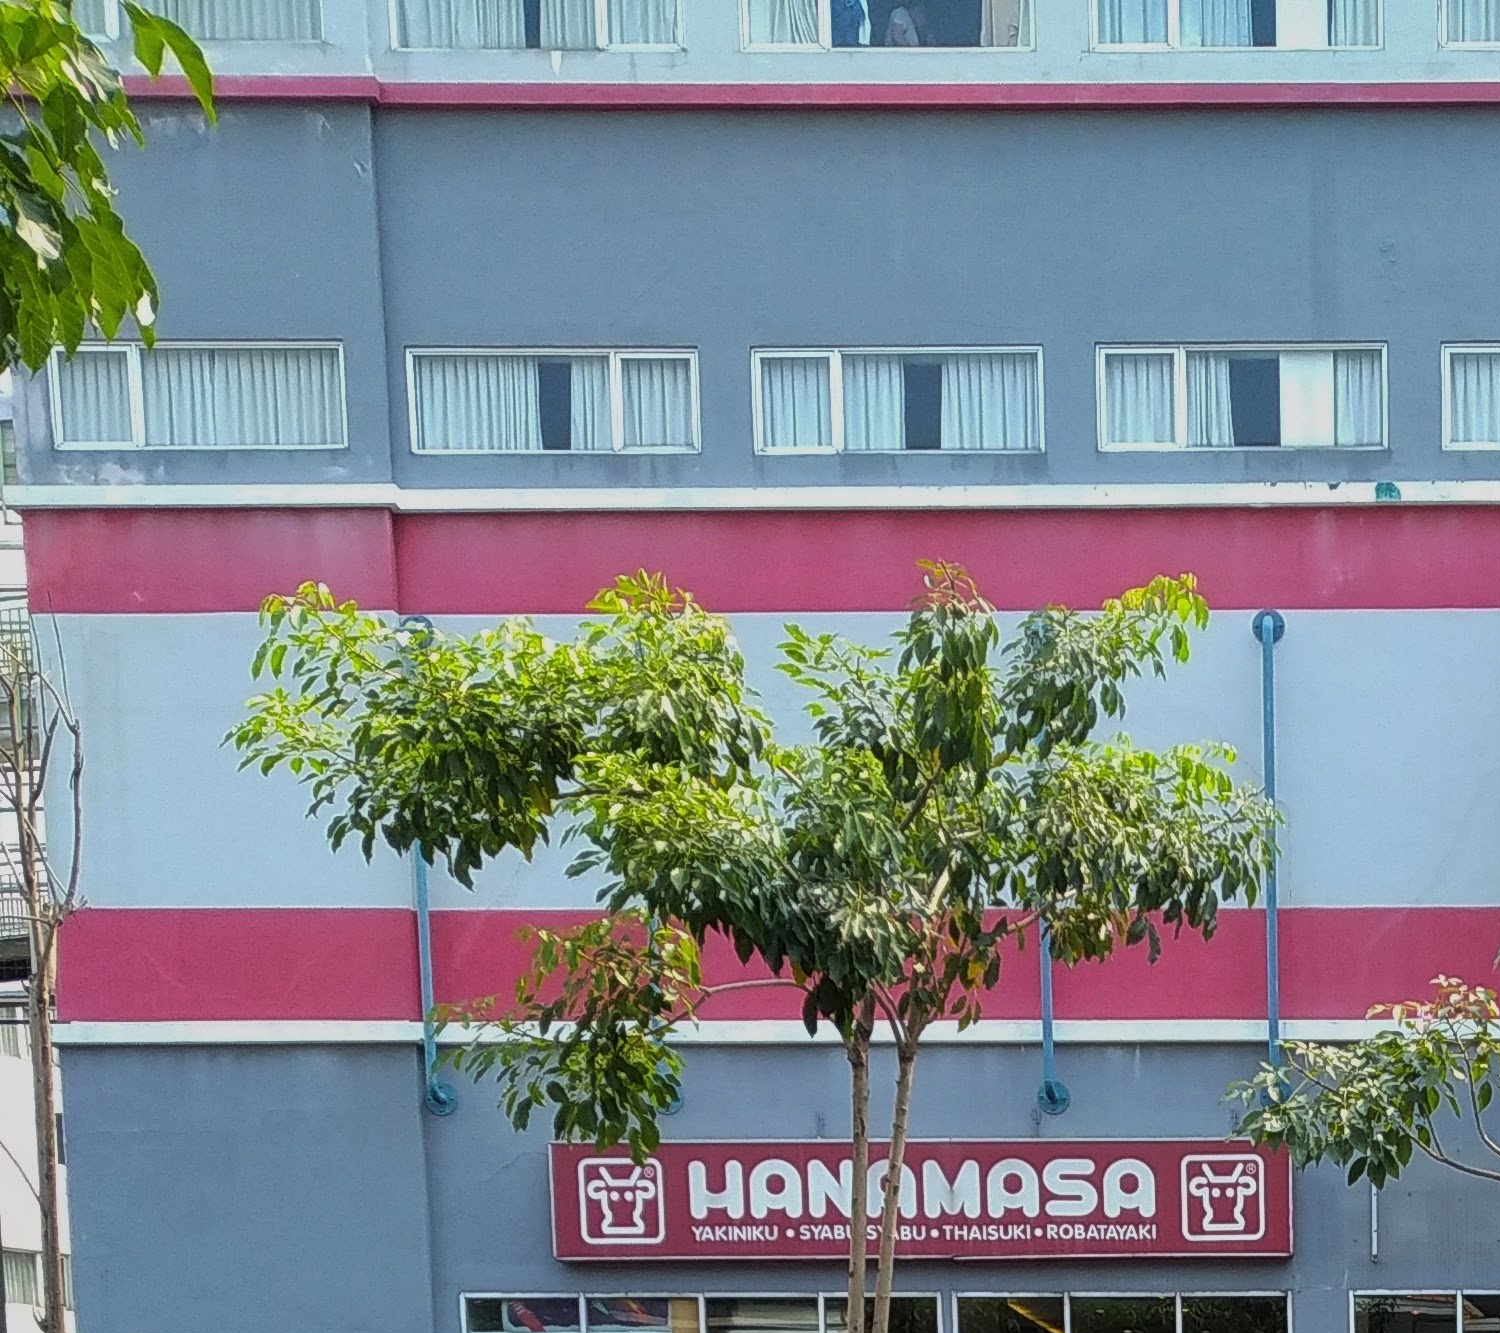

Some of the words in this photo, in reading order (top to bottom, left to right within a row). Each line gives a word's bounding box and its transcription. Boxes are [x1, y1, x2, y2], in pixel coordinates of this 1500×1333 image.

[687, 1157, 1157, 1220] HANAMASA
[691, 1224, 779, 1243] YAKINIKU
[942, 1223, 1032, 1242] THAISUKI
[1046, 1222, 1158, 1241] ROBATAYAKI
